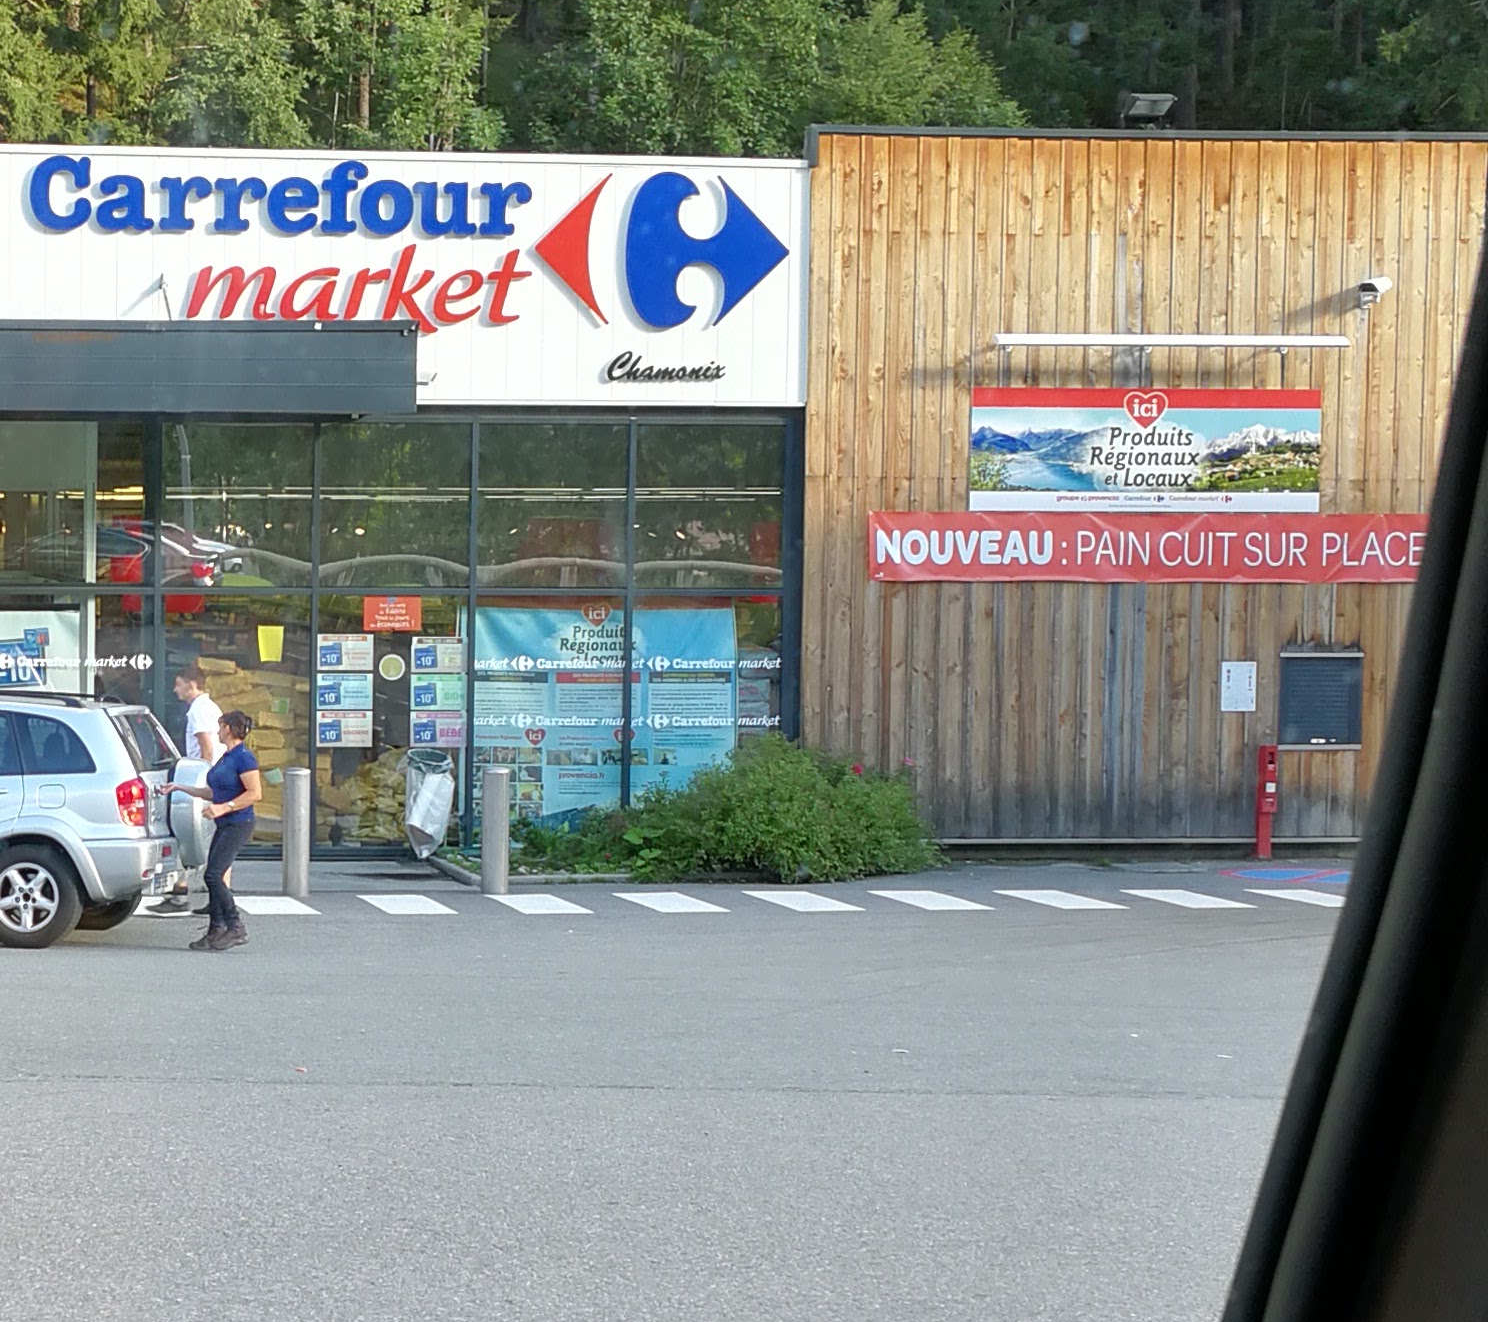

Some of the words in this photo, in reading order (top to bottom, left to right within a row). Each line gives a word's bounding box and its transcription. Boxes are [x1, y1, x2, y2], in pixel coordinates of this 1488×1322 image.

[28, 155, 533, 238] Carrefour
[186, 244, 533, 333] market
[606, 350, 726, 381] Chamonix
[1132, 398, 1159, 418] ici
[1109, 426, 1194, 446] Produits
[1090, 446, 1200, 471] Régionaux
[1104, 473, 1118, 486] et
[1123, 467, 1193, 488] Locaux
[875, 529, 1054, 566] NOUVEAU
[1076, 530, 1151, 566] PAIN
[1158, 531, 1238, 567] CUIT
[1243, 531, 1309, 567] SUR
[1321, 531, 1428, 567] PLACE
[588, 607, 607, 620] ici
[572, 624, 625, 639] Produit
[16, 655, 81, 668] Carrefour
[84, 655, 128, 668] market
[535, 658, 600, 669] Carrefour
[672, 658, 736, 669] Carrefour
[738, 658, 783, 670] market
[535, 715, 599, 726] Carrefour
[671, 715, 735, 727] Carrefour
[737, 715, 782, 727] market
[528, 730, 542, 741] ici
